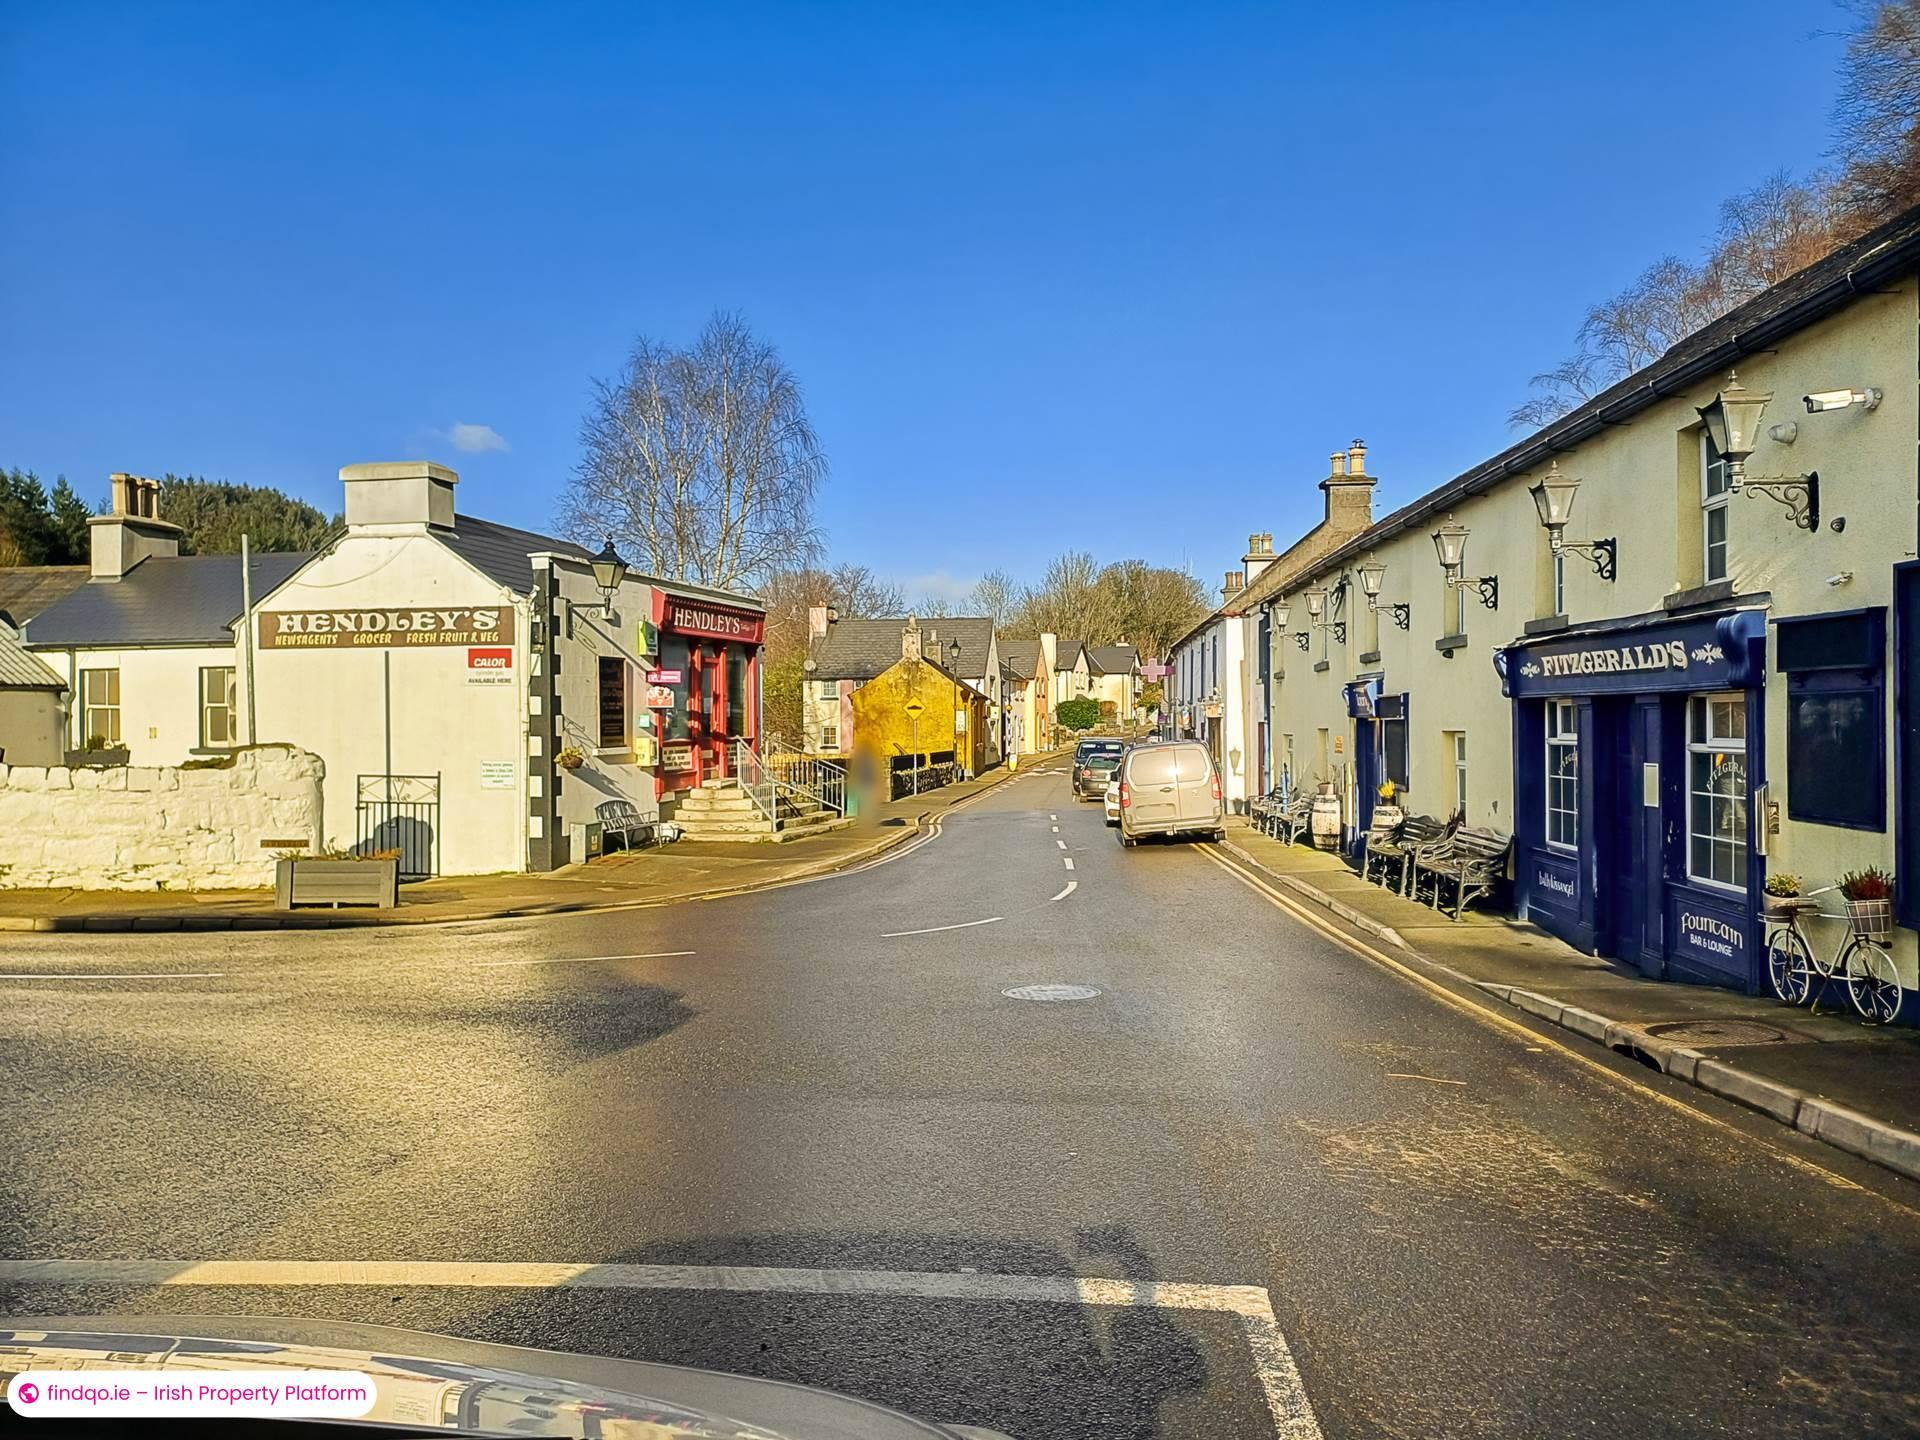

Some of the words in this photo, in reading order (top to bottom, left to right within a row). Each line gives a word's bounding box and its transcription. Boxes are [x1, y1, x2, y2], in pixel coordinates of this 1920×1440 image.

[275, 610, 500, 633] HENDLEY'S
[673, 607, 741, 634] HENDLEY'S
[275, 633, 338, 646] NEWSAGENTS
[353, 632, 392, 645] GROCER
[406, 632, 437, 644] FRESH
[439, 631, 468, 643] FRUIT
[470, 631, 478, 643] &
[480, 631, 499, 642] VEG
[474, 658, 506, 669] CALOR
[1541, 640, 1688, 676] FITZGERALD'S
[1690, 933, 1703, 946] BAR
[1708, 939, 1733, 957] LOUNGE
